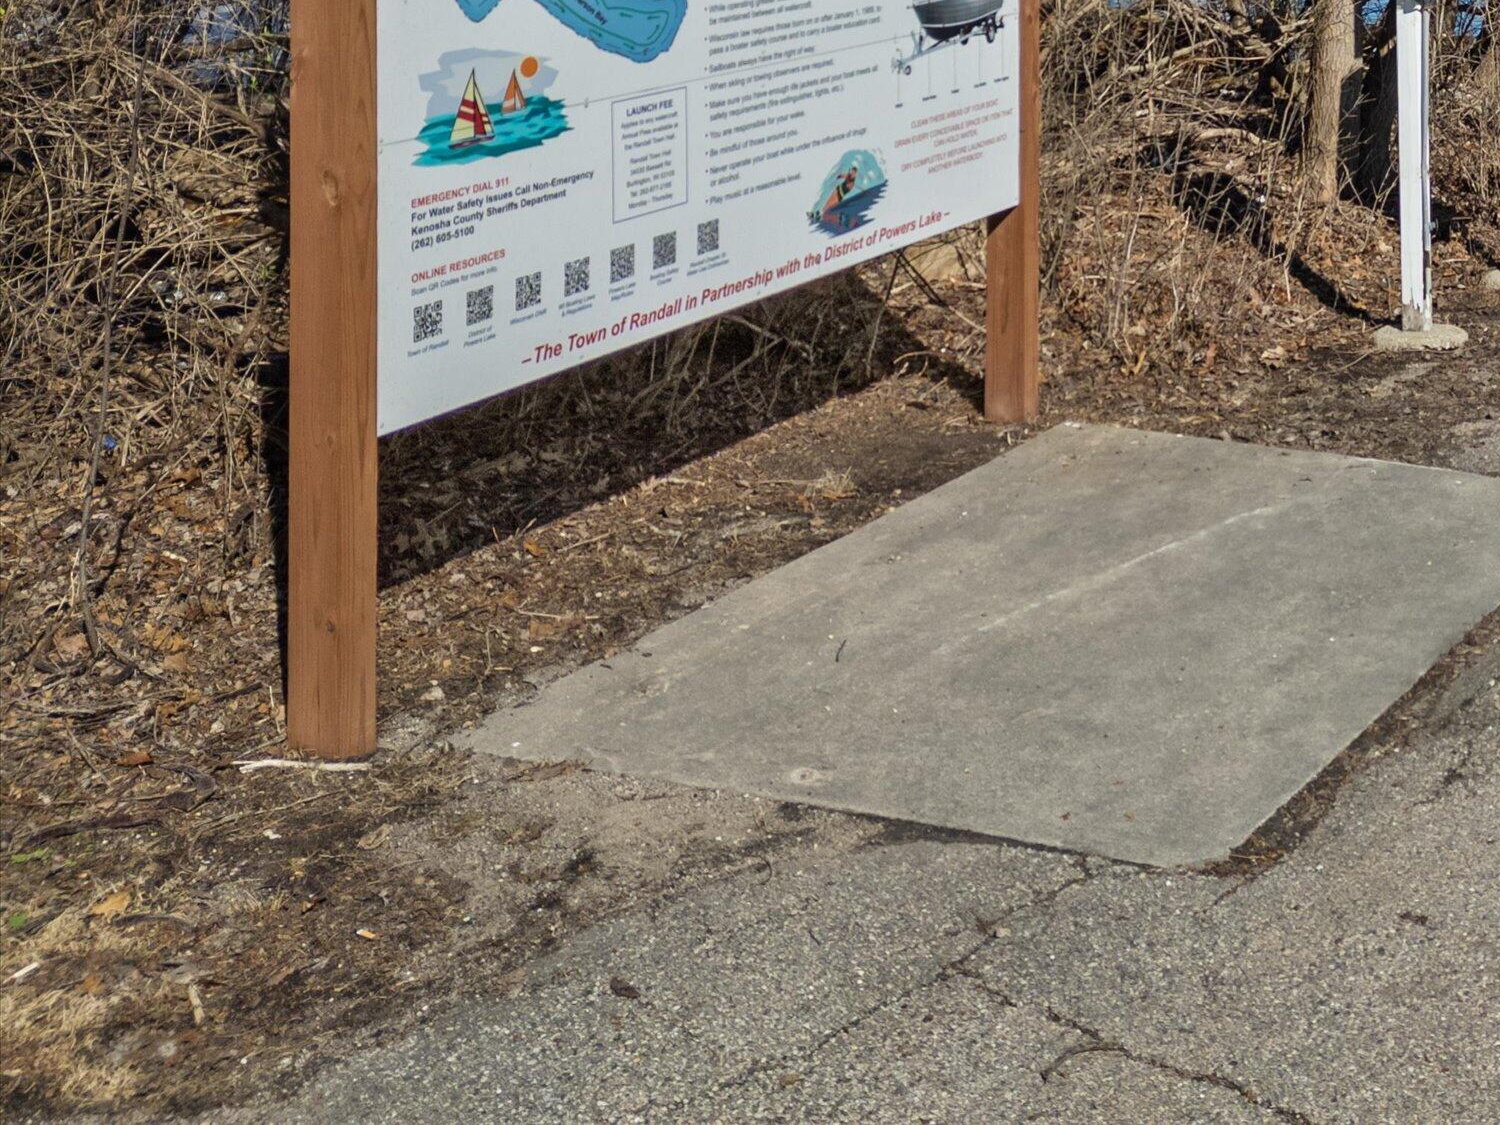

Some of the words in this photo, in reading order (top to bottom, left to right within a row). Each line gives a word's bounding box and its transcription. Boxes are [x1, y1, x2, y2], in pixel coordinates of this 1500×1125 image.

[626, 103, 657, 116] LAUNCH
[658, 98, 672, 109] FEE
[410, 185, 470, 208] EMERGENCY
[472, 181, 493, 193] DIAL
[495, 176, 508, 188] 911
[411, 211, 426, 222] For
[428, 205, 454, 217] Water
[456, 198, 483, 210] Safety
[485, 190, 512, 203] Issues
[514, 184, 530, 196] Call
[532, 171, 593, 191] Non-Emergency
[411, 219, 450, 236] Kenosha
[452, 210, 484, 225] County
[520, 188, 566, 207] Department
[411, 236, 433, 251] (262)
[435, 225, 474, 243] 605-5100
[411, 264, 446, 283] ONLINE
[449, 248, 505, 272] RESOURCES
[568, 327, 606, 351] Town
[610, 315, 627, 336] of
[629, 297, 682, 330] Randall
[684, 294, 697, 311] in
[700, 269, 773, 305] Partnership
[776, 257, 800, 278] with
[803, 252, 821, 268] the
[823, 236, 863, 262] District
[865, 229, 877, 246] of
[878, 220, 916, 242] Powers
[918, 208, 941, 228] Lake
